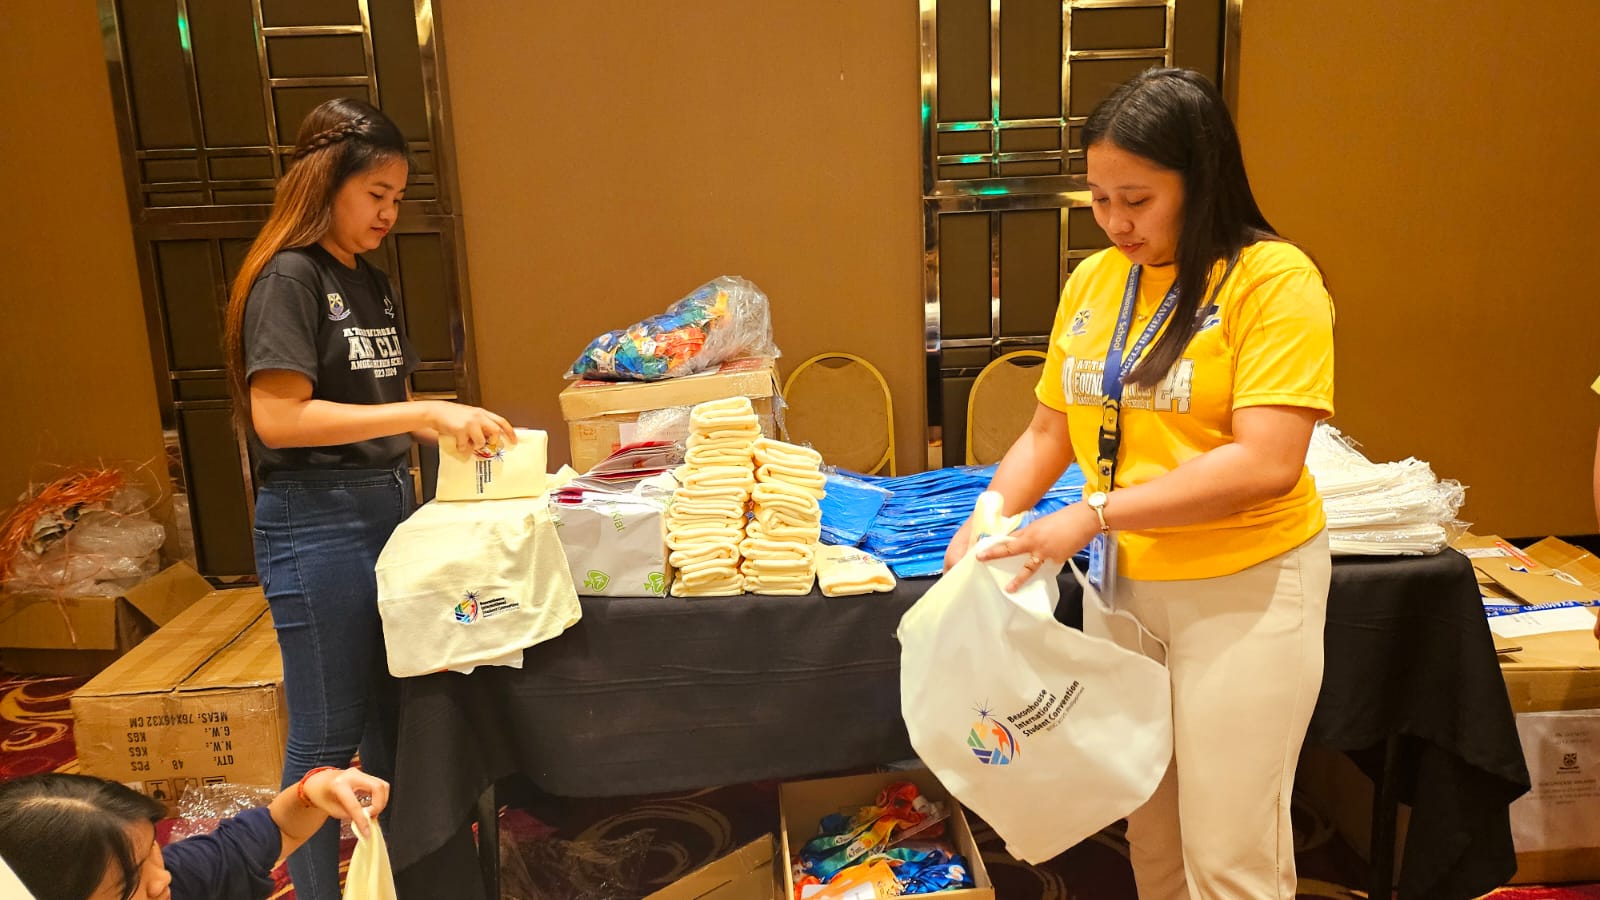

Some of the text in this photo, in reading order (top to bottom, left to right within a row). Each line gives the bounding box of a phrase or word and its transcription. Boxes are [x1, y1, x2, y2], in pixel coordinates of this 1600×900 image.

[1139, 333, 1151, 345] IN
[1147, 293, 1177, 333] HEAVEN
[1113, 321, 1127, 351] School
[198, 711, 228, 723] MEAS:
[1006, 689, 1047, 723] Beaconhouse
[1014, 693, 1057, 730] International
[1022, 680, 1080, 737] Student Convention
[129, 716, 144, 728] CM
[127, 732, 146, 743] KGS
[129, 746, 148, 757] KGS
[130, 755, 234, 771] QTY: 48 PCS
